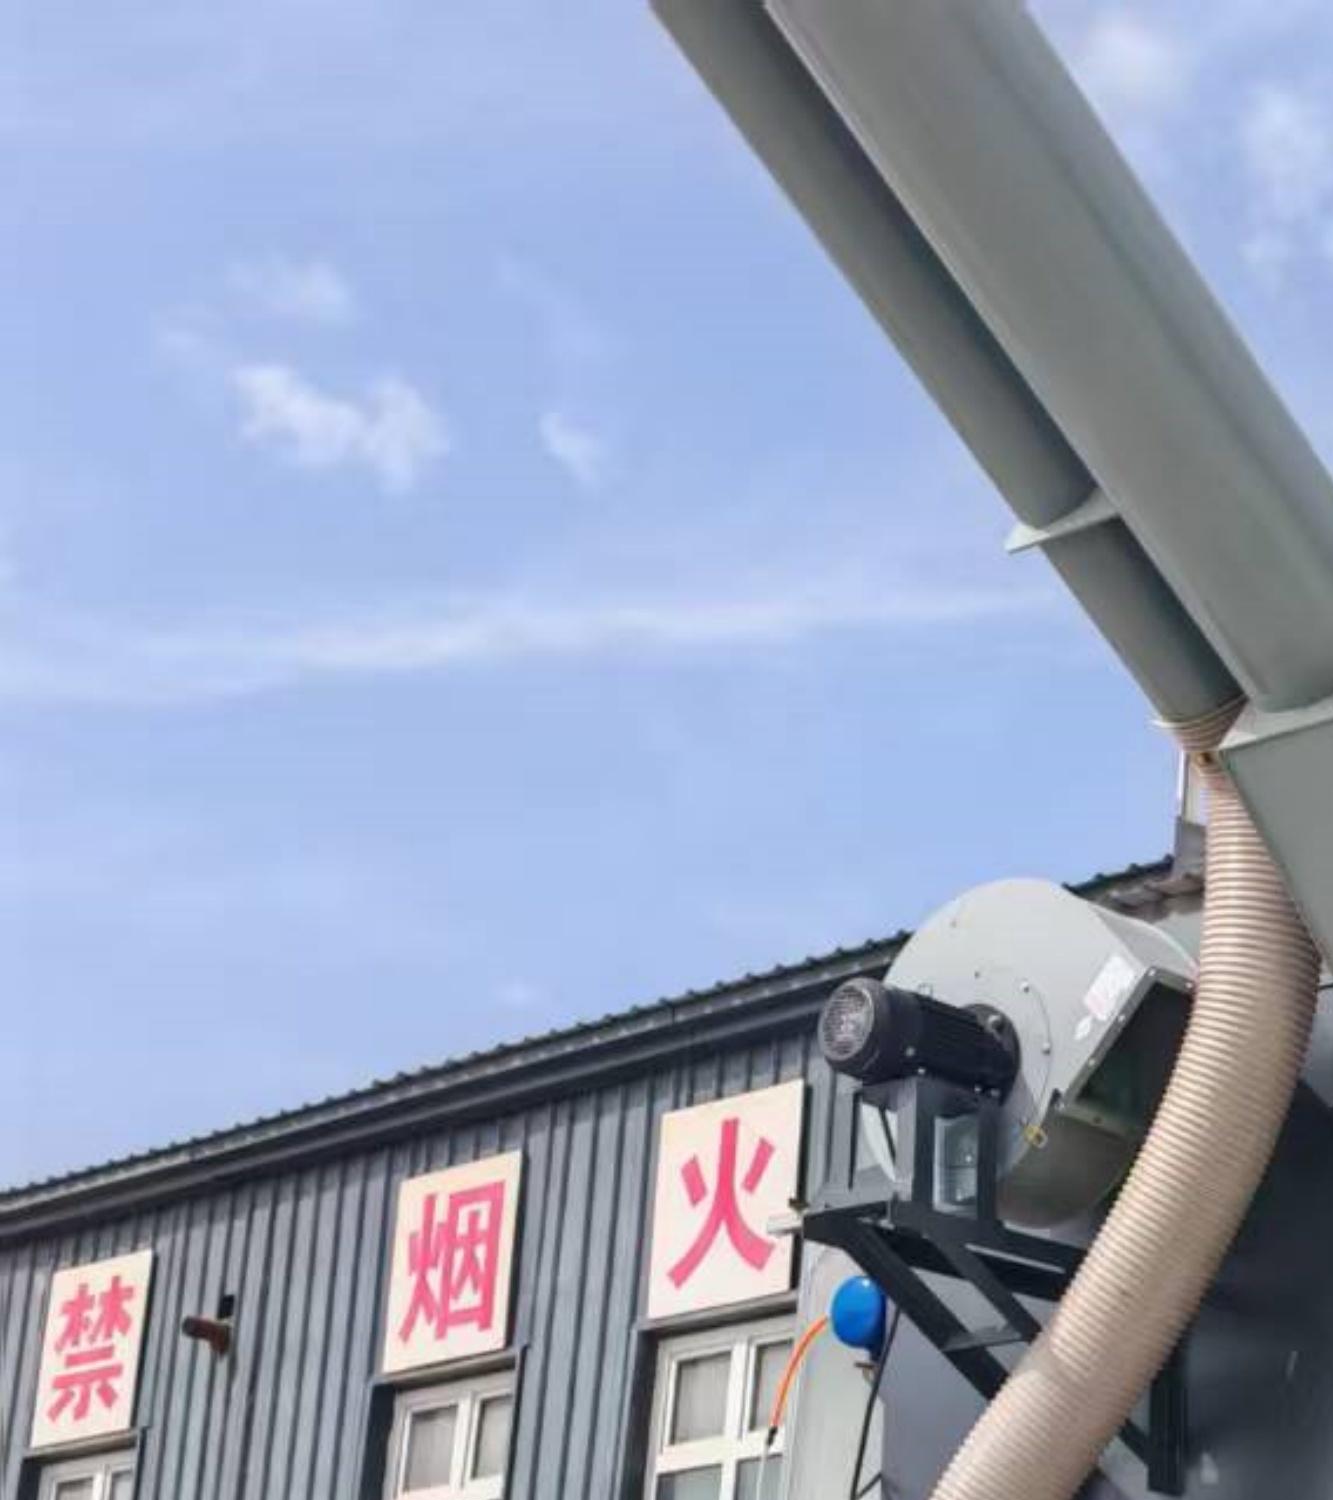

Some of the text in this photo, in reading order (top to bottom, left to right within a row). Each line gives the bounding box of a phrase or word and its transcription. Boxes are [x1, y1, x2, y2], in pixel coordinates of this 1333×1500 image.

[48, 1117, 776, 1422] 禁 烟 火
